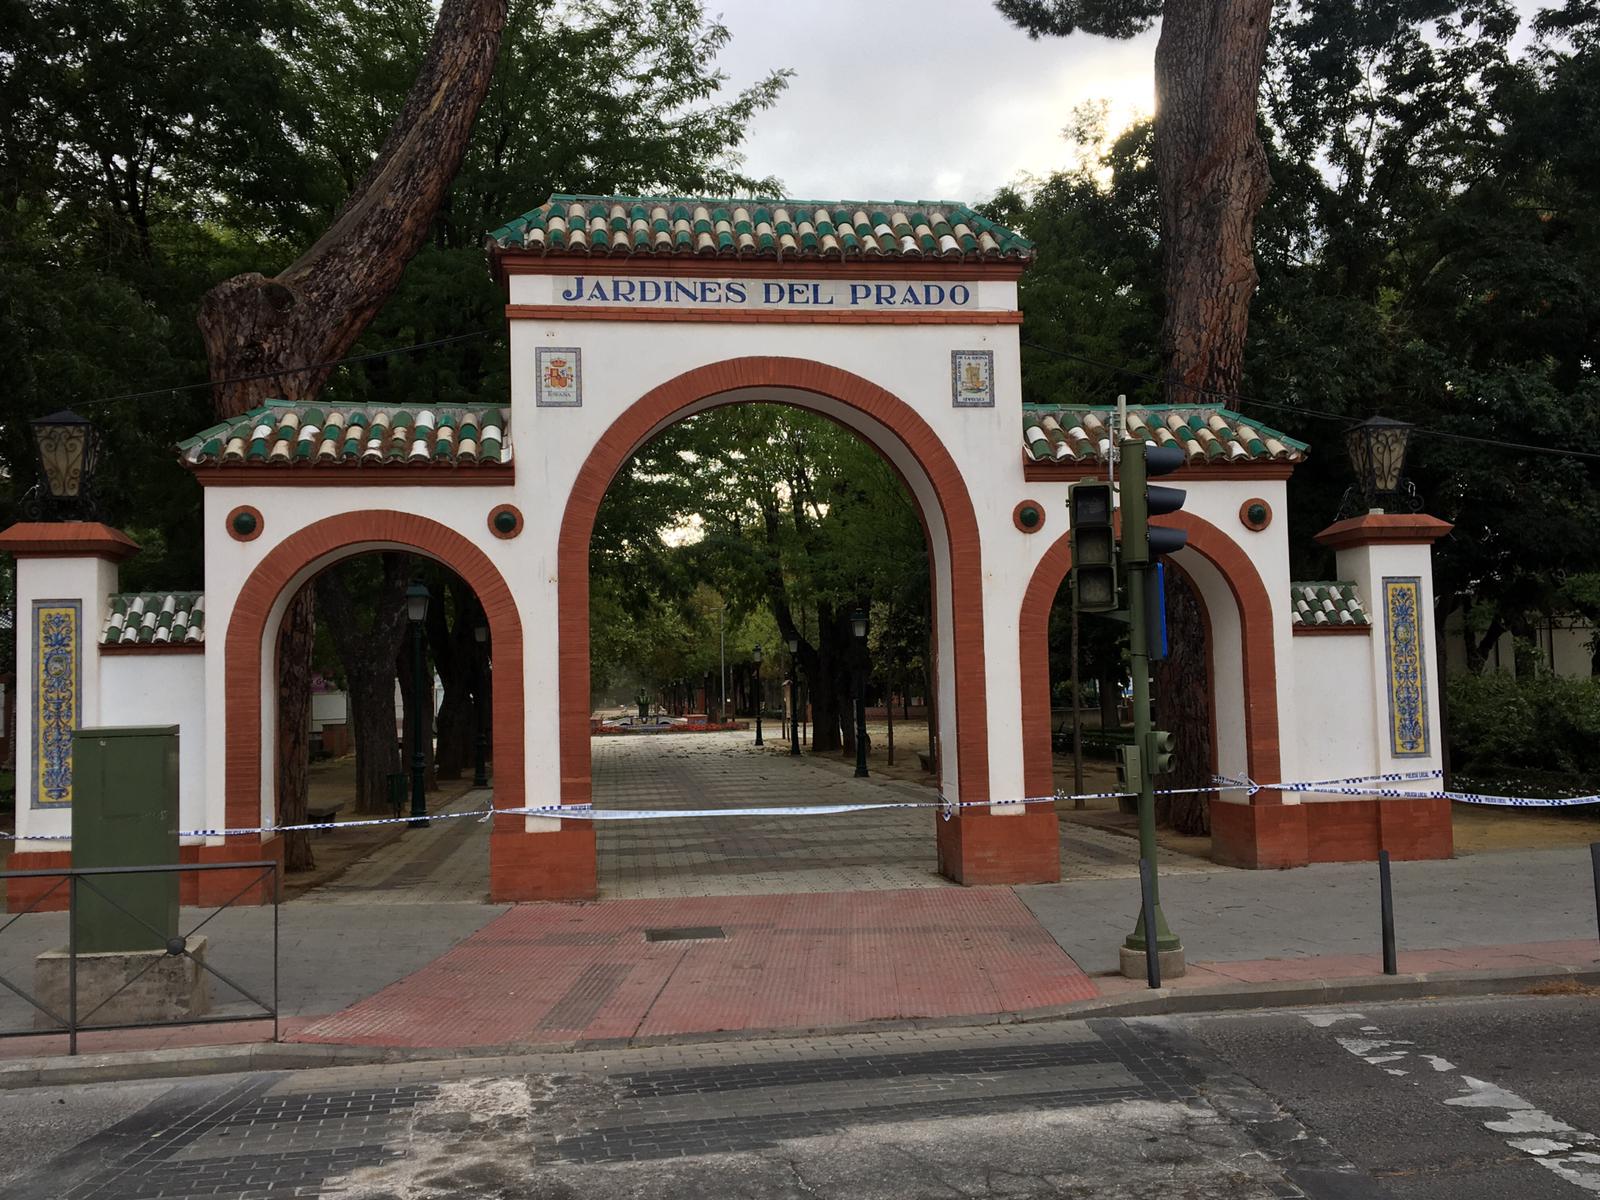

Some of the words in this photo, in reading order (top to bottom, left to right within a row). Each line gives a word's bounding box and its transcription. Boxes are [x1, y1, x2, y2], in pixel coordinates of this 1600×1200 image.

[562, 276, 747, 304] JARDINES
[763, 283, 834, 305] DEL
[849, 284, 970, 306] PRADO
